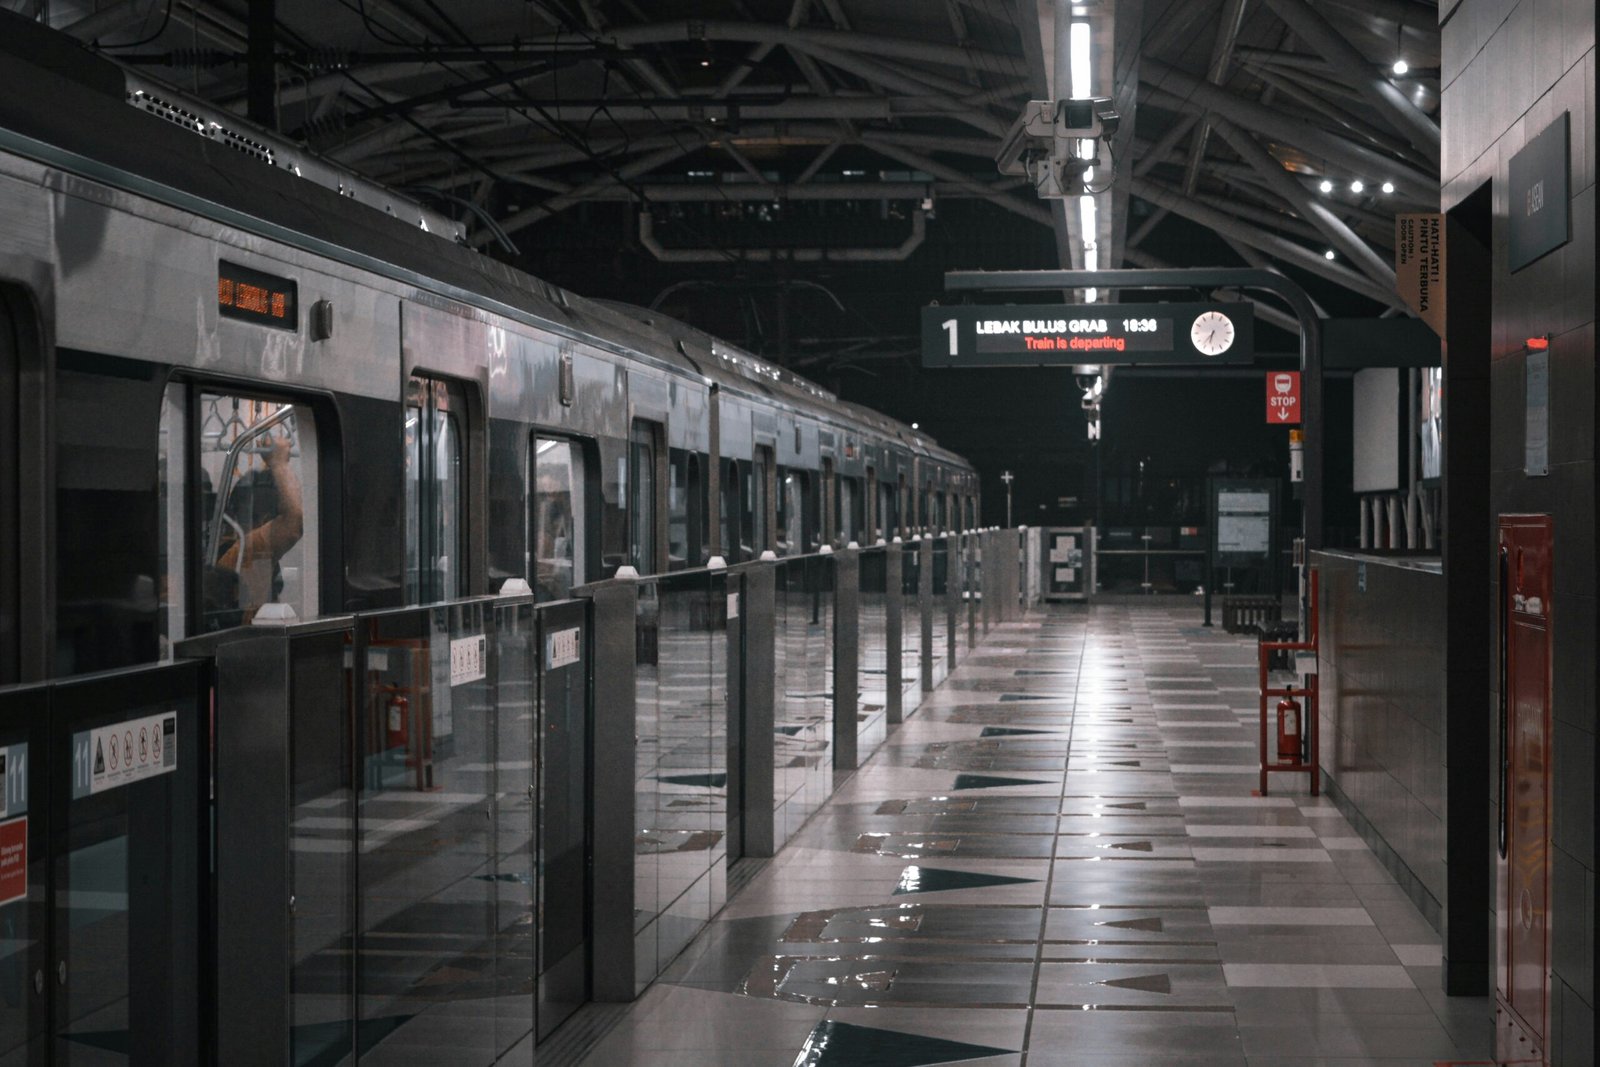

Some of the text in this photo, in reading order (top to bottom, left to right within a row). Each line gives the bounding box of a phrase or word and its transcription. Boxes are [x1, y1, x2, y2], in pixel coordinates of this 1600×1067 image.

[1420, 218, 1428, 312] PINTU TERBUKA
[1430, 218, 1439, 276] HATI-HATI
[942, 319, 958, 356] 1
[976, 320, 1020, 334] LEBAK
[1023, 320, 1066, 334] BULUS
[1068, 320, 1107, 333] GRAB
[1024, 336, 1125, 351] Train is departing
[1270, 396, 1296, 406] STOP
[10, 753, 25, 803] 11
[75, 741, 89, 788] 11
